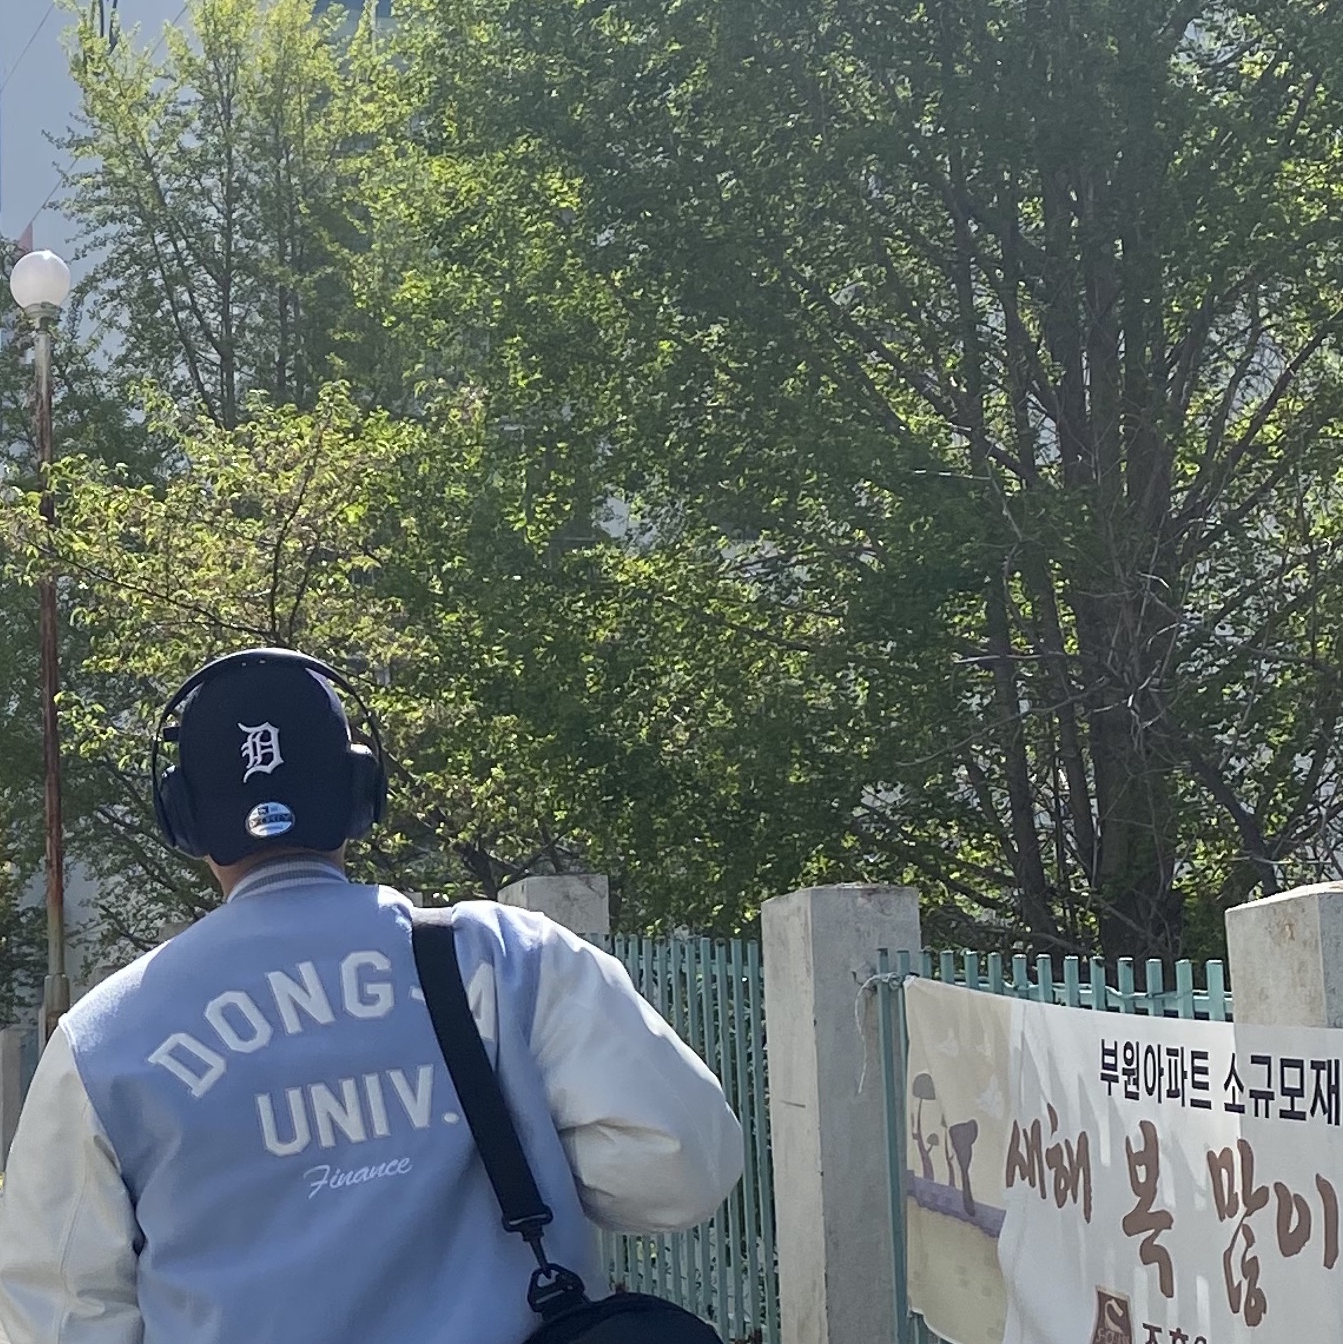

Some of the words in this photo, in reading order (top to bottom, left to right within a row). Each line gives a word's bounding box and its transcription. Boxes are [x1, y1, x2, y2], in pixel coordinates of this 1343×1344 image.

[237, 721, 284, 784] D
[255, 1063, 460, 1158] UNIV.
[1100, 1038, 1213, 1110] 부원아파트
[1223, 1053, 1342, 1127] 소규모재
[303, 1157, 414, 1200] Finance
[1005, 1102, 1091, 1224] 새해
[1122, 1120, 1174, 1298] 복
[1206, 1138, 1340, 1327] 많이
